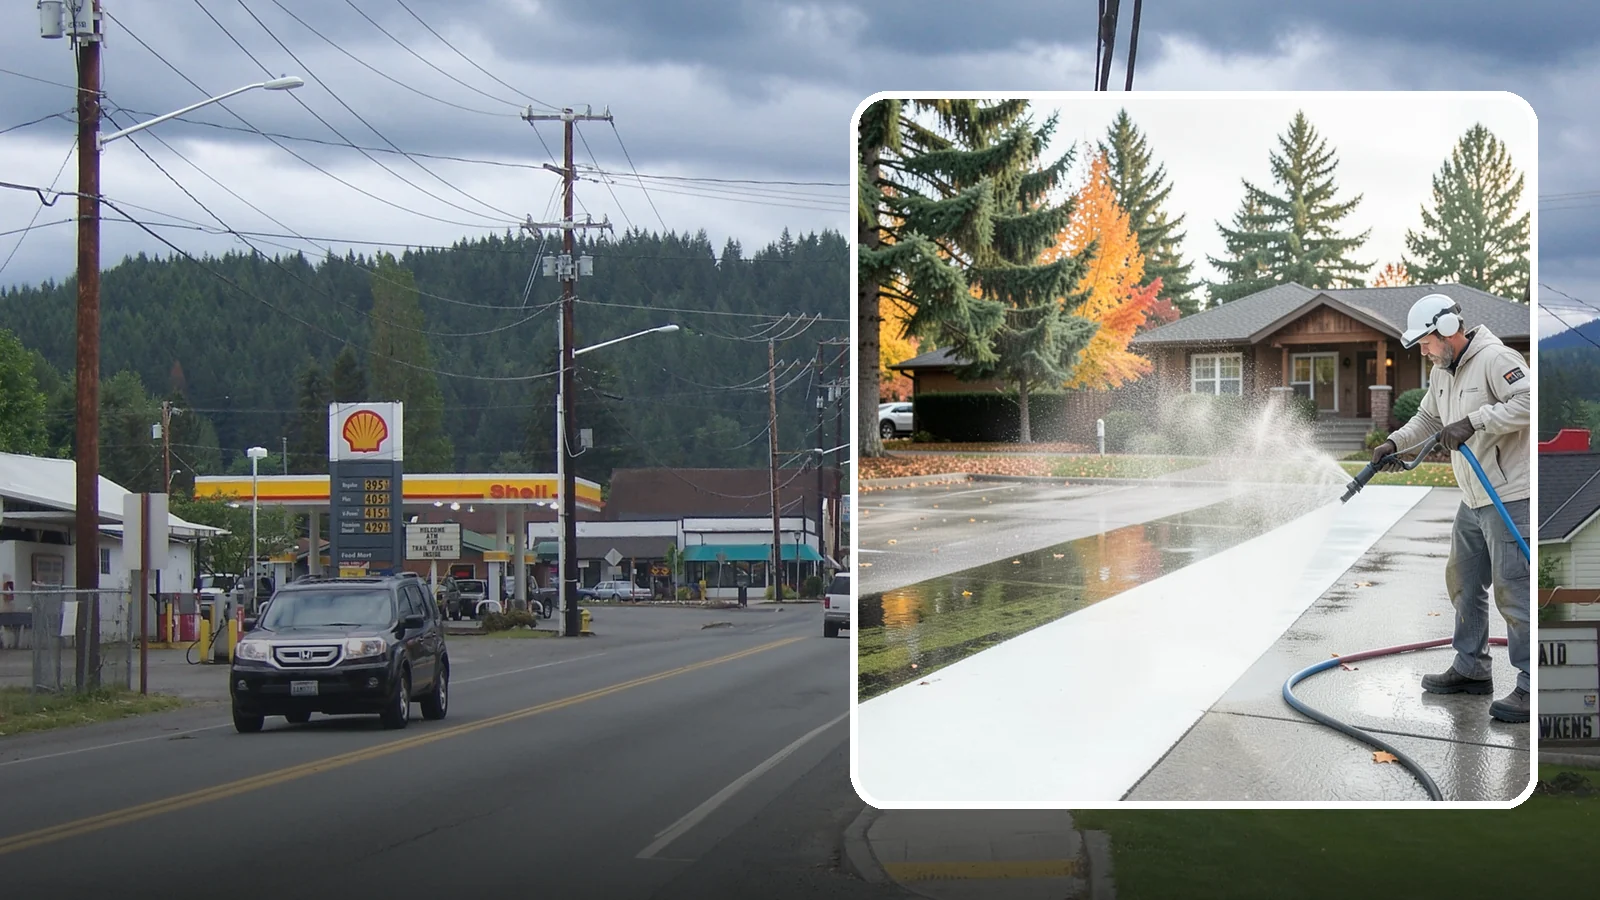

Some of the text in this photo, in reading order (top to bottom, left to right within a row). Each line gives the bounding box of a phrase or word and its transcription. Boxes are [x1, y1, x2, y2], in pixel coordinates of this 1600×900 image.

[366, 480, 384, 490] 395
[490, 484, 547, 499] Shell
[366, 494, 384, 504] 405
[366, 508, 384, 518] 415
[366, 522, 384, 532] 429
[1539, 643, 1567, 665] AID
